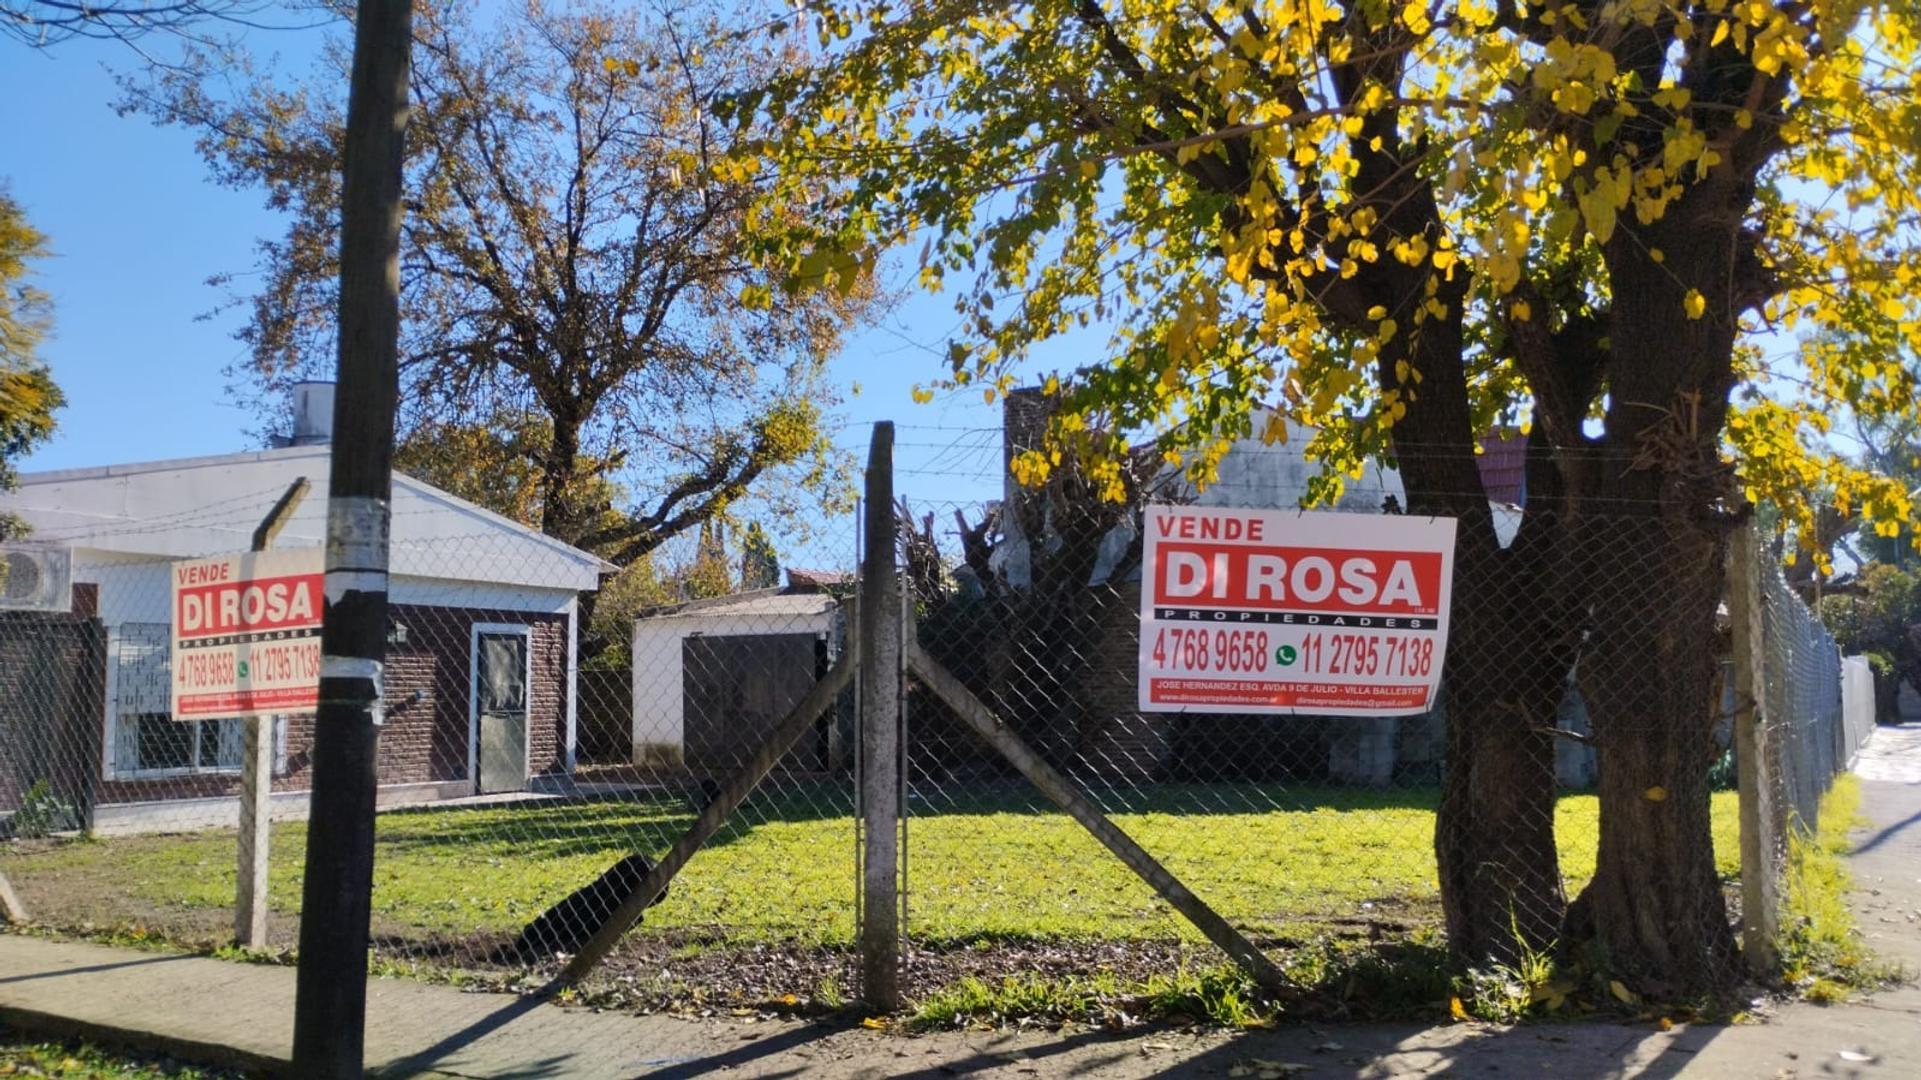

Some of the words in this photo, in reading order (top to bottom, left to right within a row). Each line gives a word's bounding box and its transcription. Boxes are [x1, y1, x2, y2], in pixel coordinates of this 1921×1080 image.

[1156, 515, 1264, 541] VENDE
[178, 562, 230, 585] VENDE
[1165, 551, 1229, 599] DI
[1246, 554, 1422, 606] ROSA
[182, 592, 213, 631] DI
[220, 581, 313, 627] ROSA
[1164, 610, 1421, 628] PROPIEDADES
[182, 629, 313, 648] PROPIEDADES
[208, 652, 234, 686] 9658
[250, 649, 261, 682] 11
[265, 646, 290, 681] 2795
[1215, 629, 1268, 673] 9658
[1302, 632, 1322, 673] 11
[1328, 634, 1379, 676] 2795
[1386, 636, 1433, 677] 7138
[1157, 680, 1181, 690] JOSE
[1183, 681, 1237, 691] HERNANDEZ
[1296, 684, 1309, 693] DE
[1311, 685, 1337, 694] JULIO
[1344, 686, 1371, 695] VILLA
[1373, 687, 1424, 696] BALLESTER
